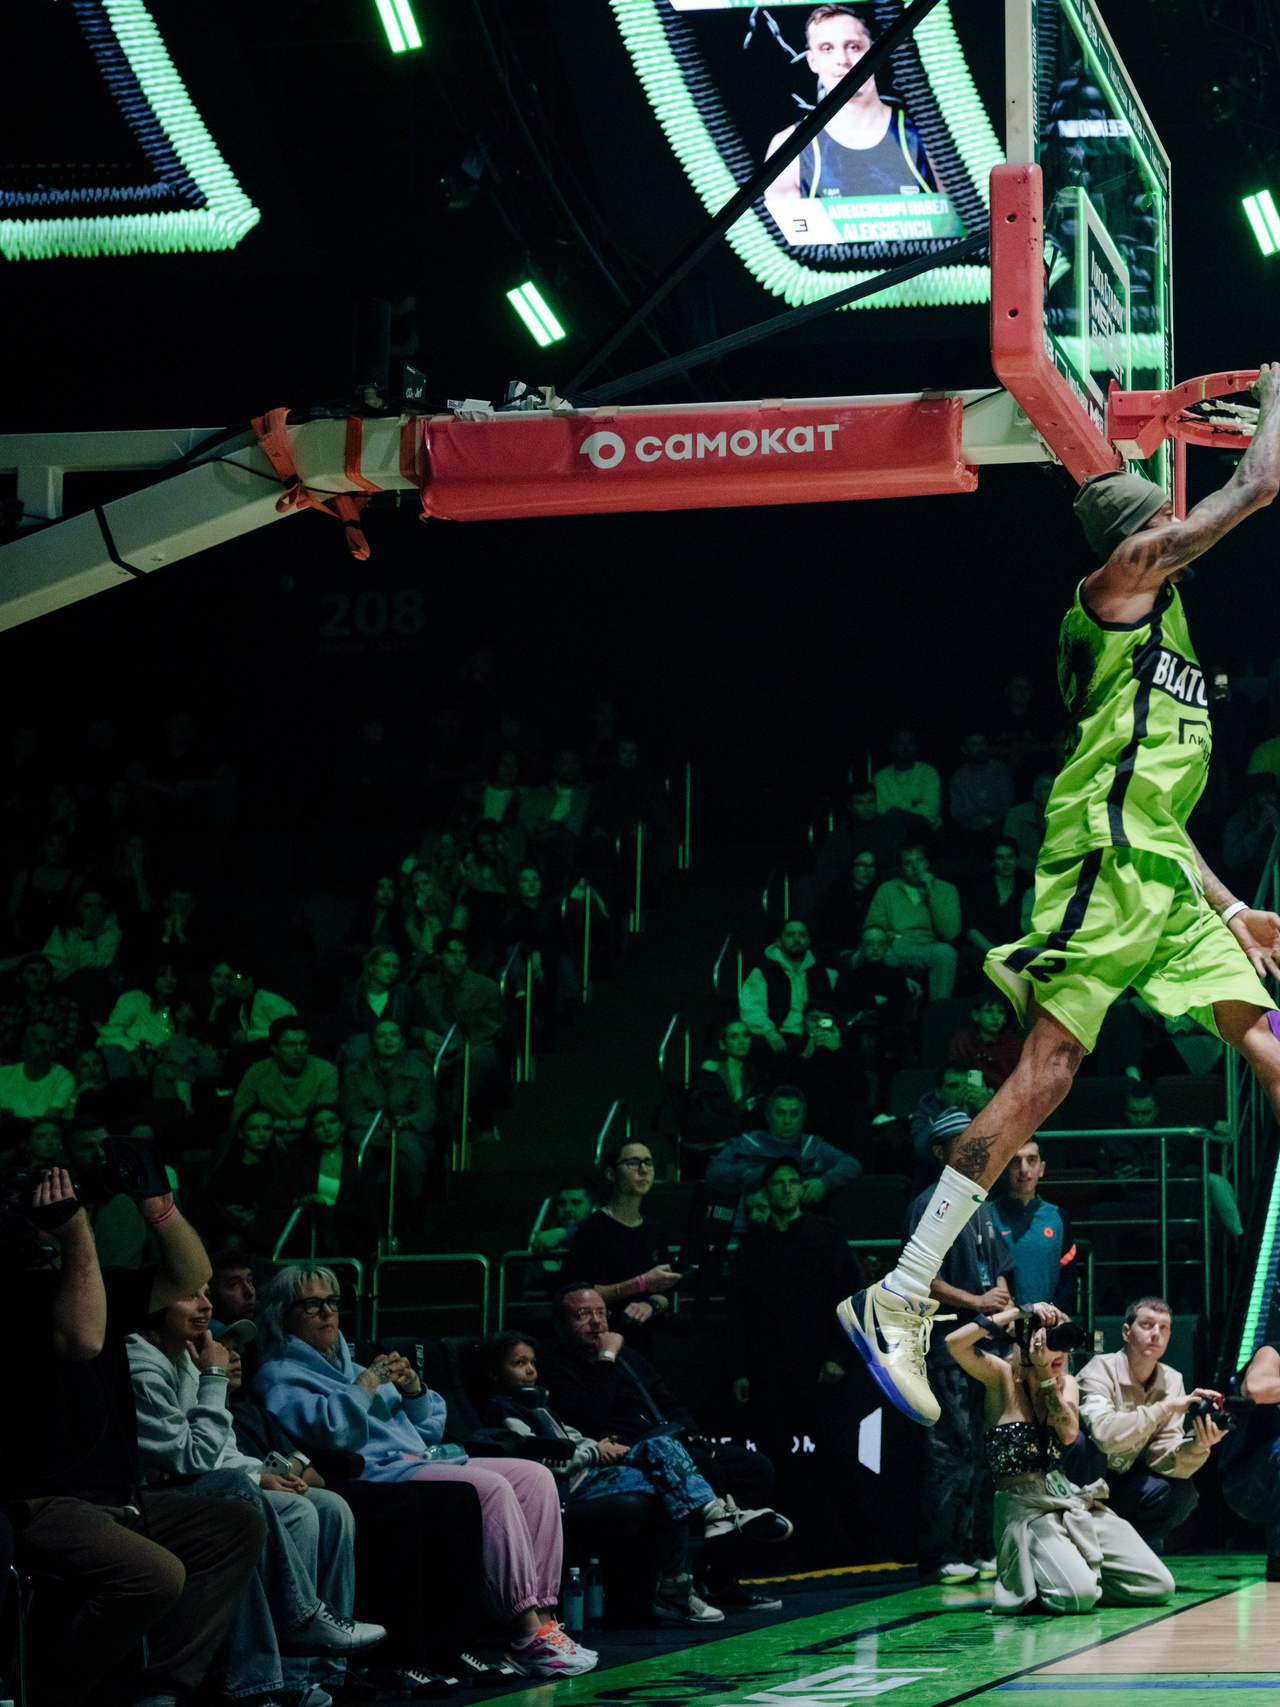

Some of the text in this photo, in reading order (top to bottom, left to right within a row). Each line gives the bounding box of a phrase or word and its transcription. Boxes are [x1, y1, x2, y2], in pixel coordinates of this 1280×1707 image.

[793, 219, 808, 233] 3
[842, 220, 933, 239] ALEKSIEVICH
[319, 589, 427, 638] 208
